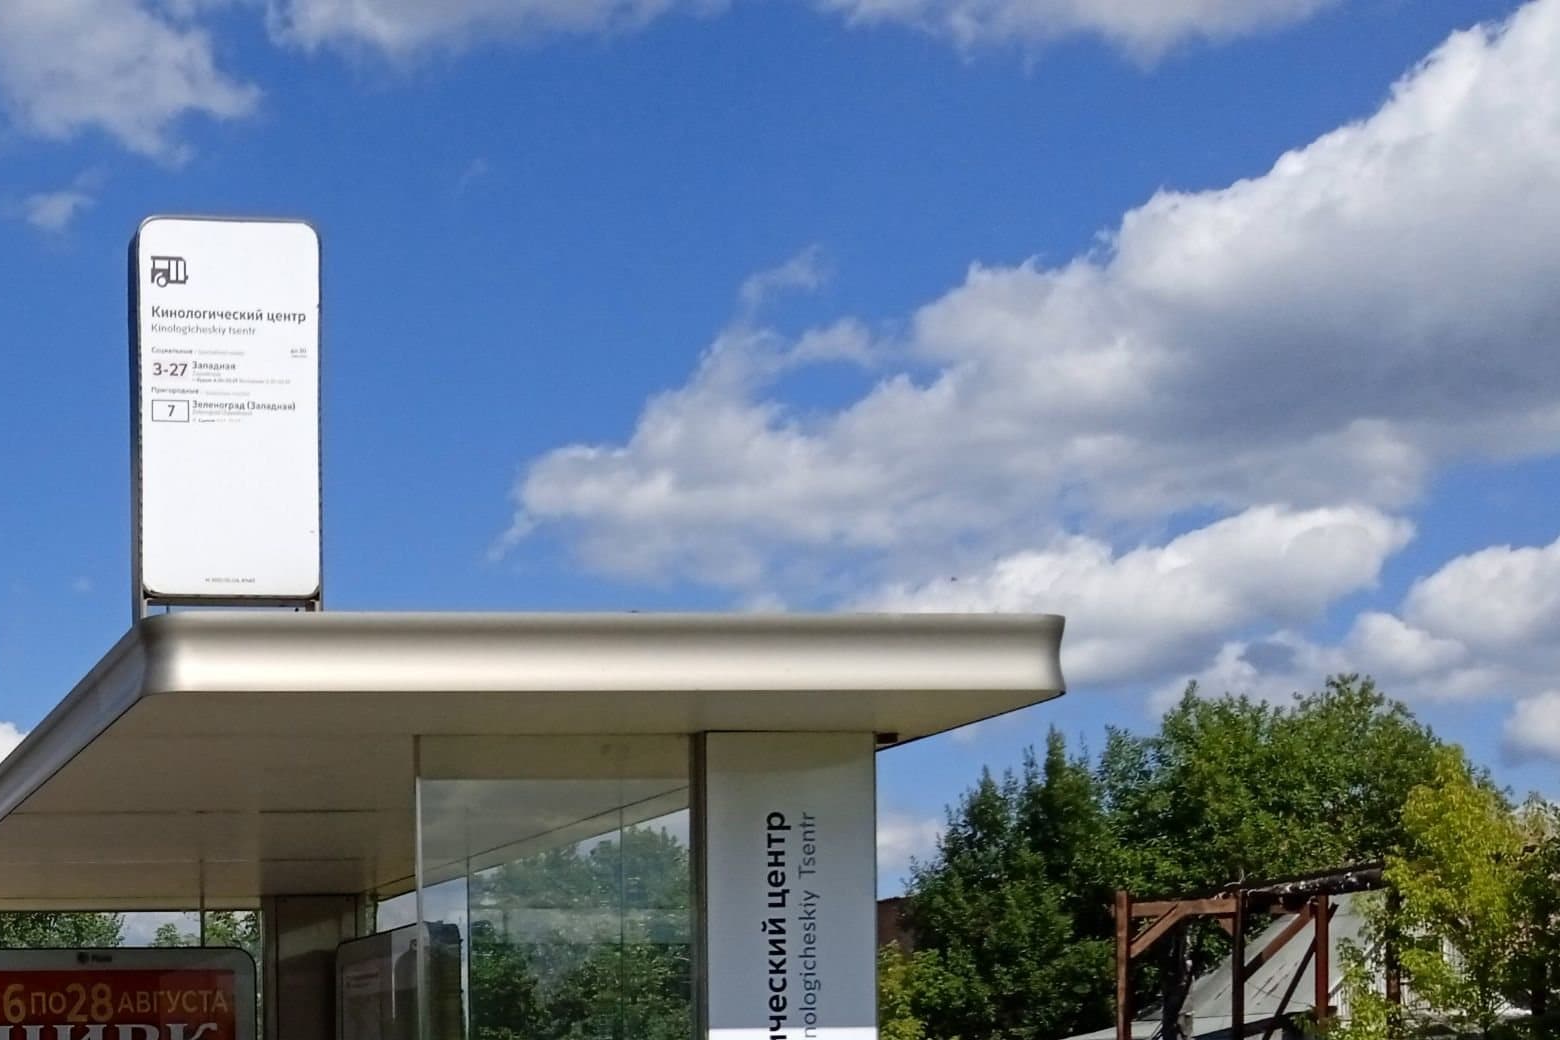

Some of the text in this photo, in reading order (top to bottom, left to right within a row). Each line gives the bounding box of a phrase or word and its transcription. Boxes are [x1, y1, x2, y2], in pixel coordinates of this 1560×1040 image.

[151, 305, 307, 325] Кинологический центр
[192, 360, 236, 371] Западная
[167, 404, 176, 417] 7
[766, 811, 792, 908] центр
[798, 812, 817, 880] Tsentr
[3, 983, 26, 1024] 6
[30, 991, 66, 1016] ПО
[65, 982, 114, 1023] 28
[117, 989, 229, 1014] АВГУСТА
